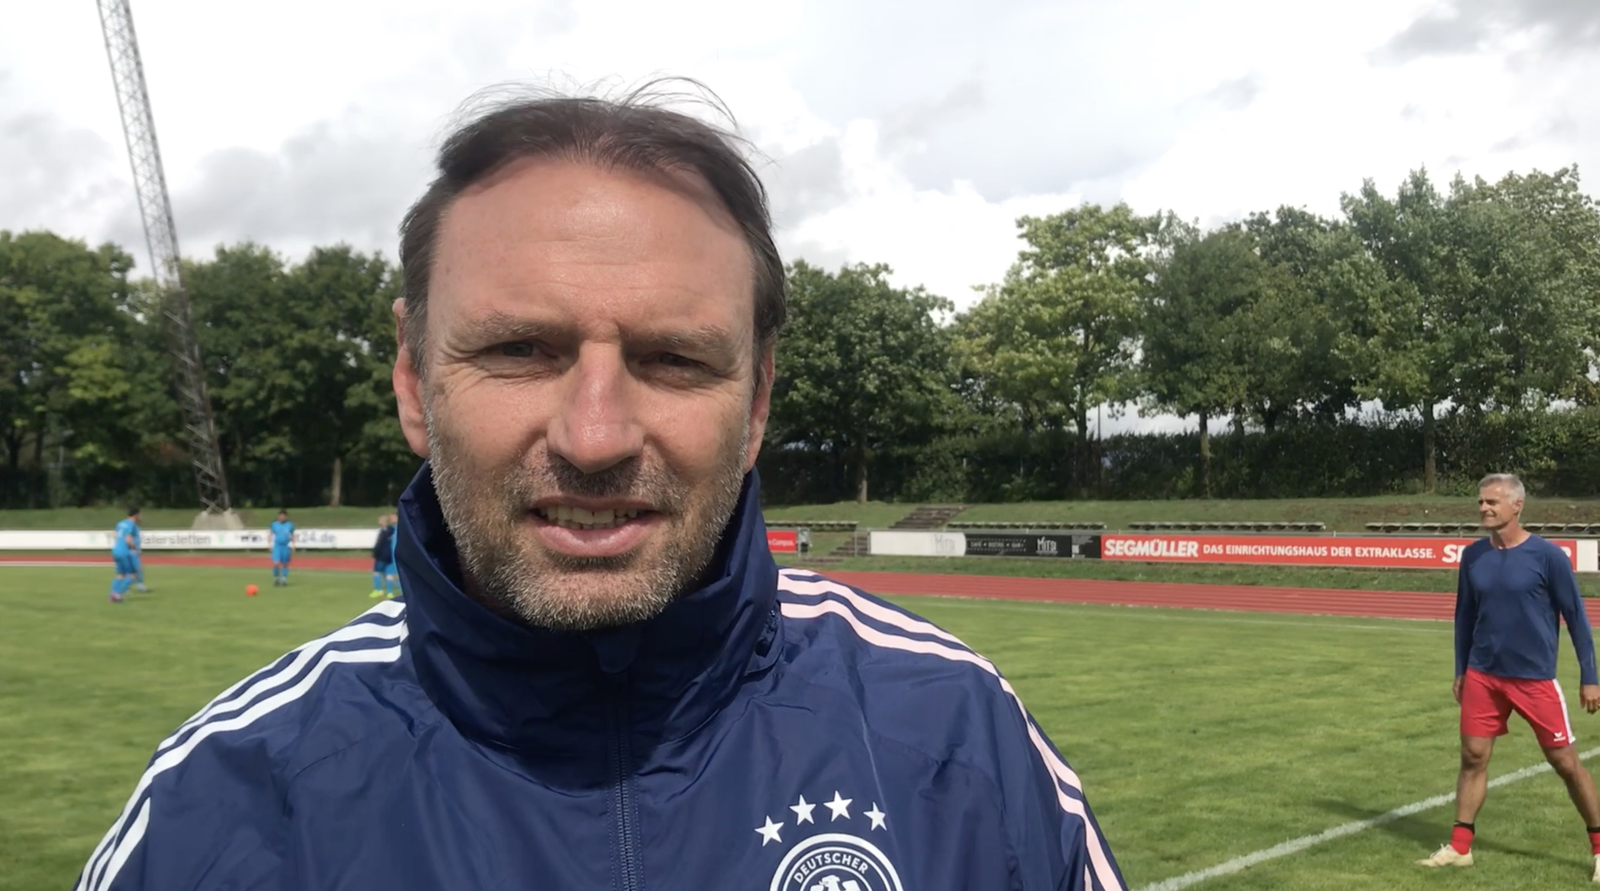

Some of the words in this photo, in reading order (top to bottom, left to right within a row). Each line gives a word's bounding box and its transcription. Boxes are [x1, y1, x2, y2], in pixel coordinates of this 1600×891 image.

[1104, 539, 1198, 558] SEGMÜLLER
[1203, 544, 1223, 555] DAS
[1225, 545, 1327, 557] EINRICHTUNGSHAUS
[1330, 546, 1352, 557] DER
[1355, 546, 1436, 559] EXTRAKLASSE.
[793, 852, 869, 884] DEUTSCHER
